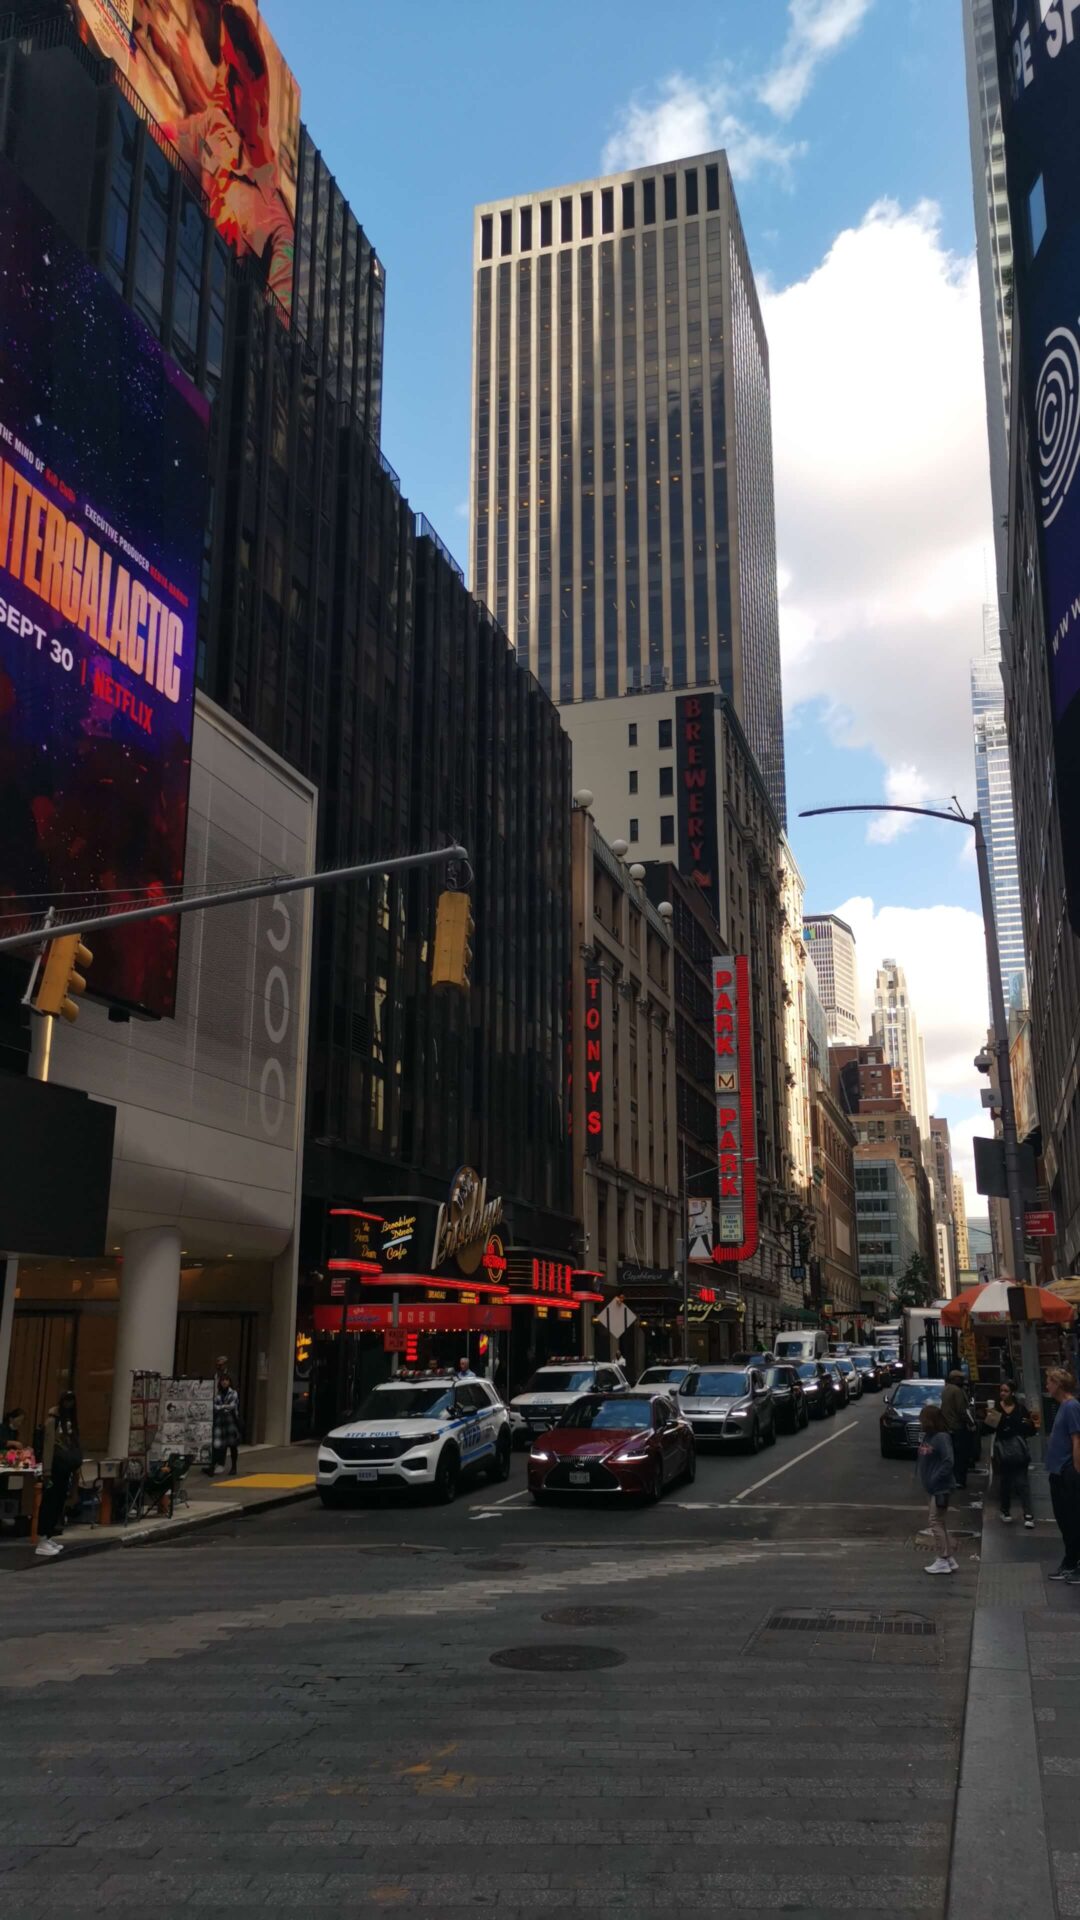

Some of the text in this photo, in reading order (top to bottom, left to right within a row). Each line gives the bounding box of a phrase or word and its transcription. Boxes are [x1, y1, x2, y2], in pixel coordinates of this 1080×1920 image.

[14, 437, 34, 465] MIND
[35, 457, 45, 474] OF
[84, 503, 119, 543] EXECUTIVE
[118, 535, 150, 572] PRODUCER
[0, 598, 74, 672] SEPT 30
[93, 667, 153, 736] NETFLIX
[683, 698, 706, 860] BREWERY
[716, 970, 735, 1056] PARK
[586, 978, 601, 1135] TONYS
[720, 1108, 739, 1197] PARK
[380, 1214, 417, 1233] Brooklyn
[386, 1243, 408, 1260] Cafe
[532, 1258, 572, 1295] DINER
